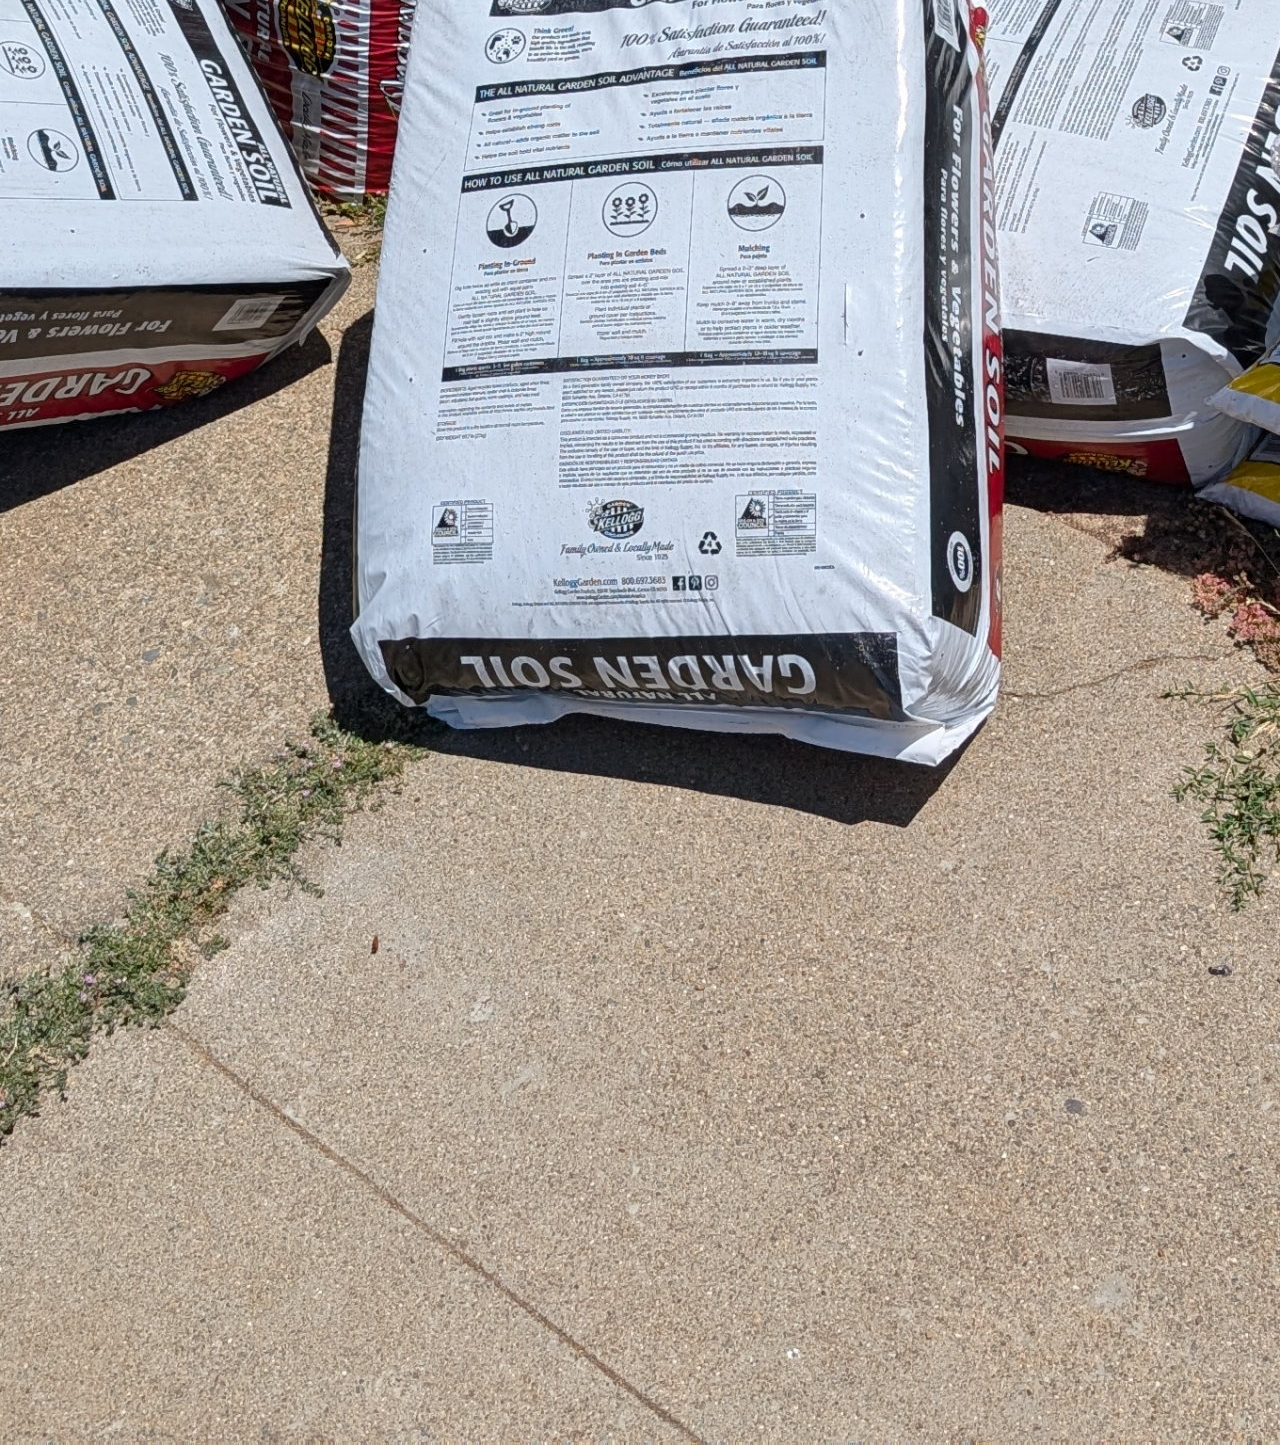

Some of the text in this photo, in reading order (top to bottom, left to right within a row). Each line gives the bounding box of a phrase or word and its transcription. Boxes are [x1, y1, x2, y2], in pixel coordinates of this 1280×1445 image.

[620, 10, 827, 48] 100% Satisfaction Guaranteed!
[479, 68, 675, 98] THE ALL NATURAL GARDEN SOIL ADVANTAGE
[200, 59, 279, 201] GARDEN SOIL
[464, 160, 656, 190] HOW TO USE ALL NATURAL GARDEN SOIL
[949, 104, 966, 428] For Flowers & Vegetables
[982, 111, 1001, 475] GARDEN SOIL
[27, 327, 42, 340] &
[46, 320, 131, 338] Flowers
[136, 319, 172, 333] For
[6, 407, 40, 422] ALL
[598, 509, 641, 530] KELLOGG
[560, 543, 587, 556] Family
[651, 541, 675, 552] Made
[460, 654, 817, 694] GARDEN SOIL
